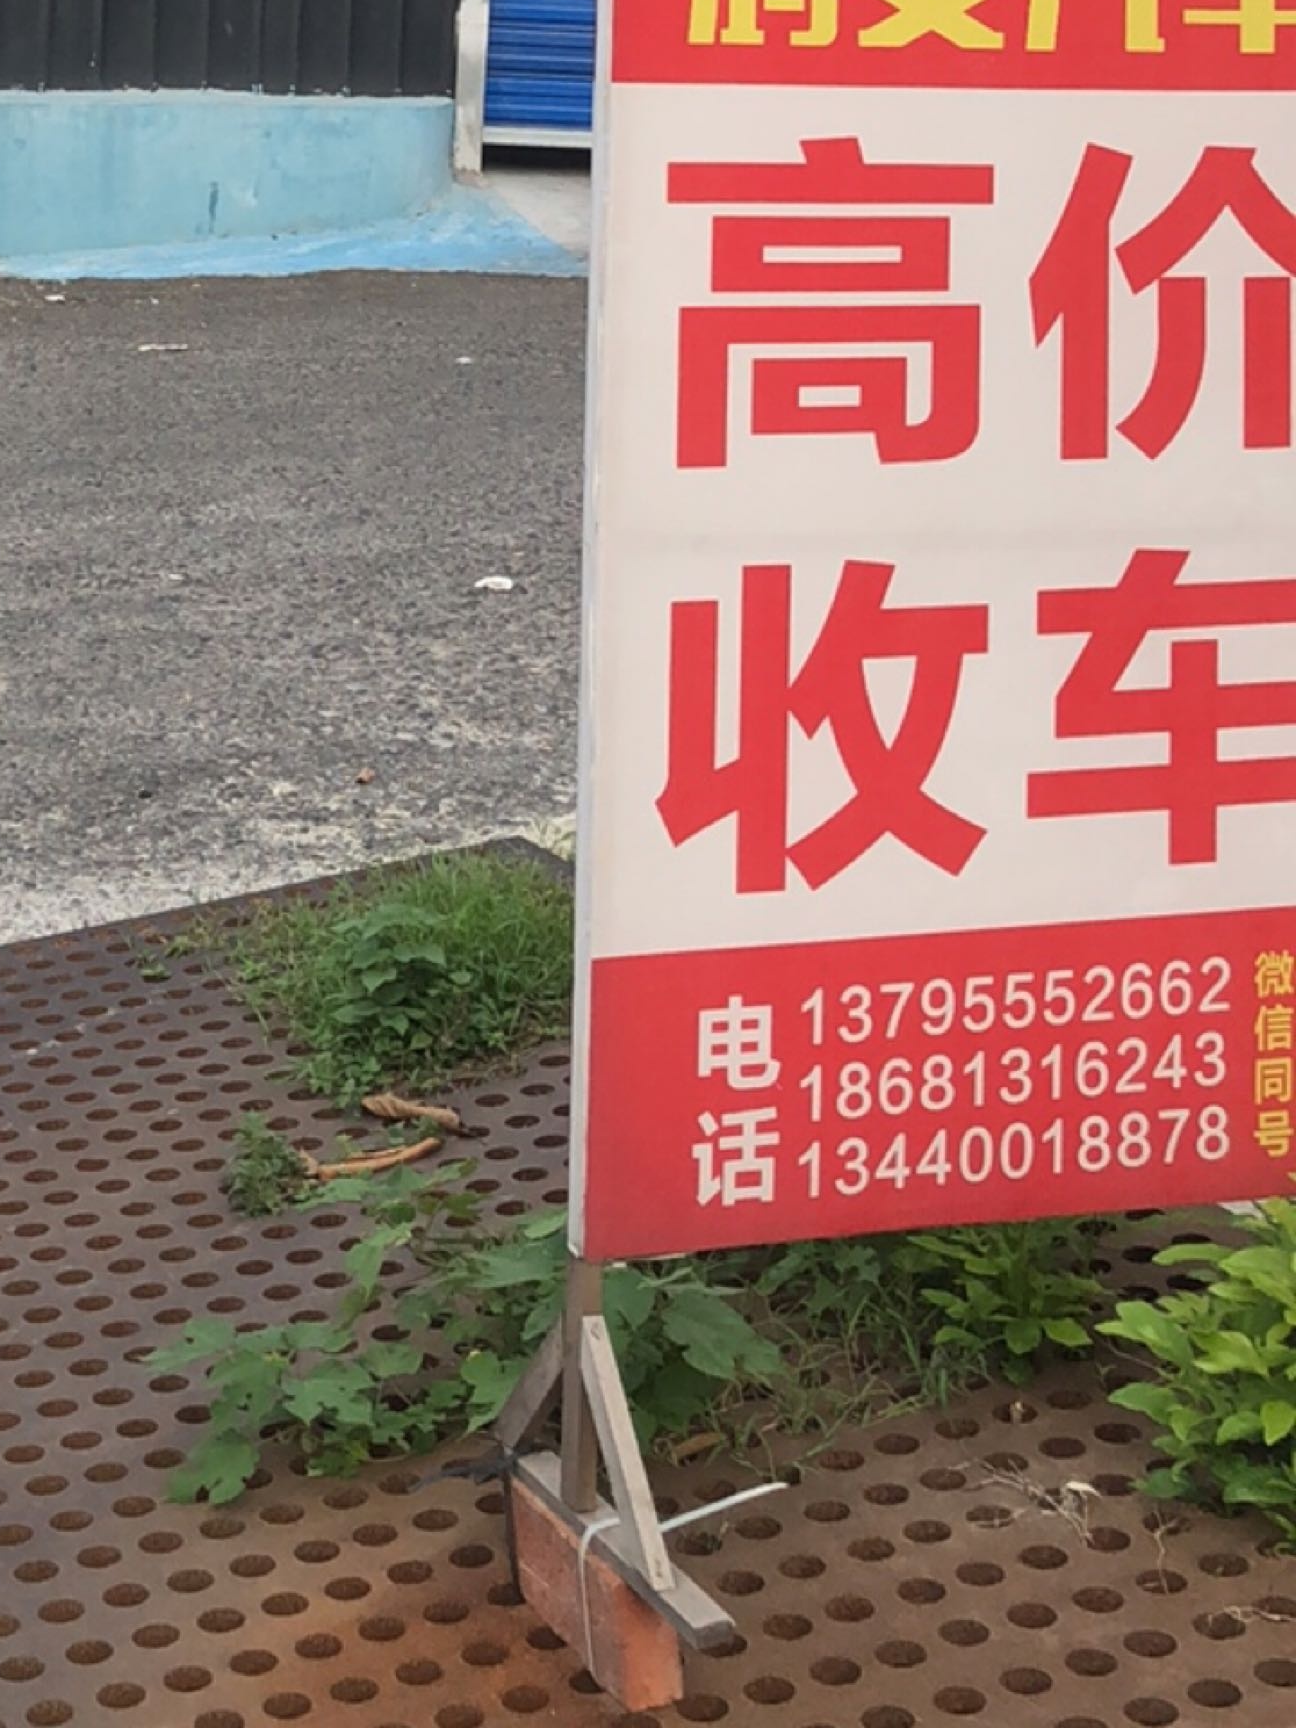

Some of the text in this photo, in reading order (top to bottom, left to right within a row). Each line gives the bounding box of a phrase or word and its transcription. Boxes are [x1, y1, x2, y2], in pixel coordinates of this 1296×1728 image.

[666, 136, 1296, 470] 高价
[654, 548, 1296, 895] 收车
[690, 995, 782, 1208] 电话
[798, 1030, 1228, 1123] 18681316243
[799, 955, 1233, 1048] 13795552662
[1253, 949, 1296, 1159] 微信同号
[797, 1104, 1231, 1200] 13440018878
